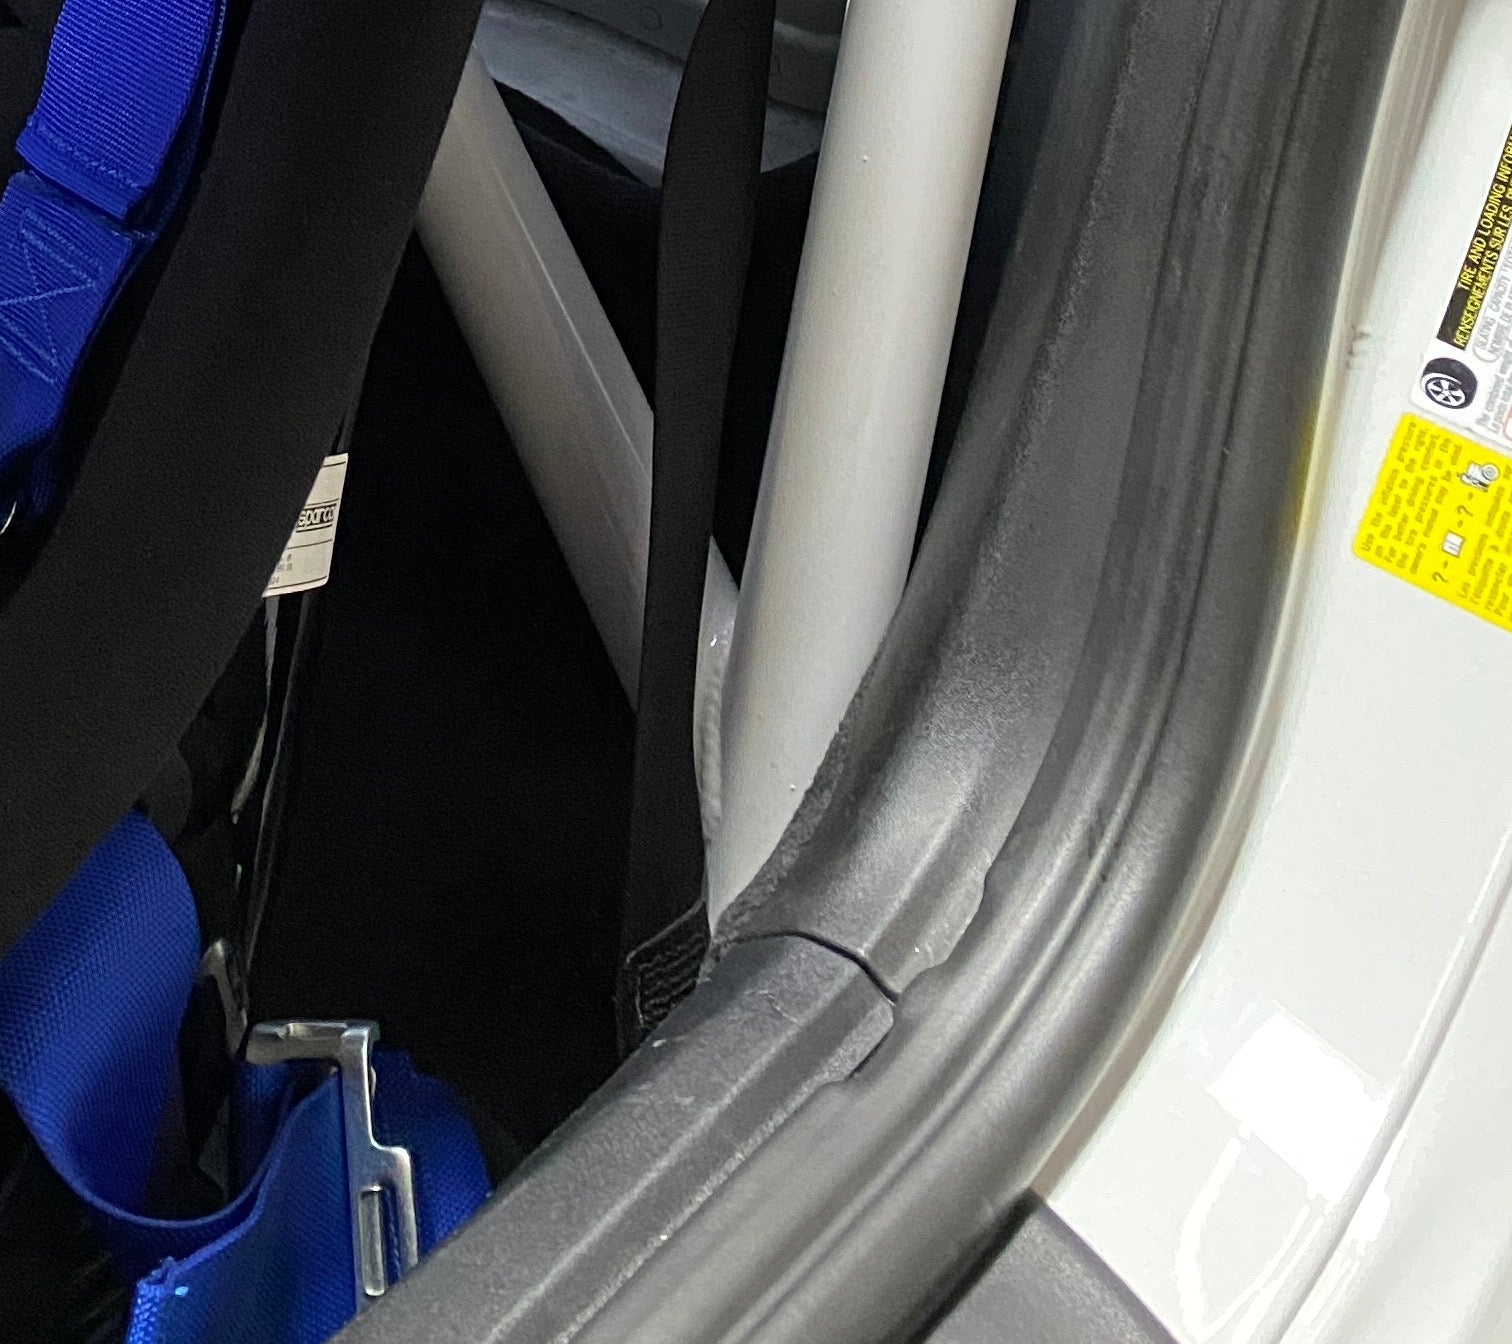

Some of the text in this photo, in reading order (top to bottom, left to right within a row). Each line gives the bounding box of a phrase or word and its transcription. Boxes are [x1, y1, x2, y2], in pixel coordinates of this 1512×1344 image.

[1454, 249, 1499, 346] RENSEIGNEMENTS
[1489, 227, 1505, 250] SUR
[1458, 264, 1476, 290] TIRE
[1469, 237, 1486, 264] AND
[1479, 183, 1506, 236] LOADING
